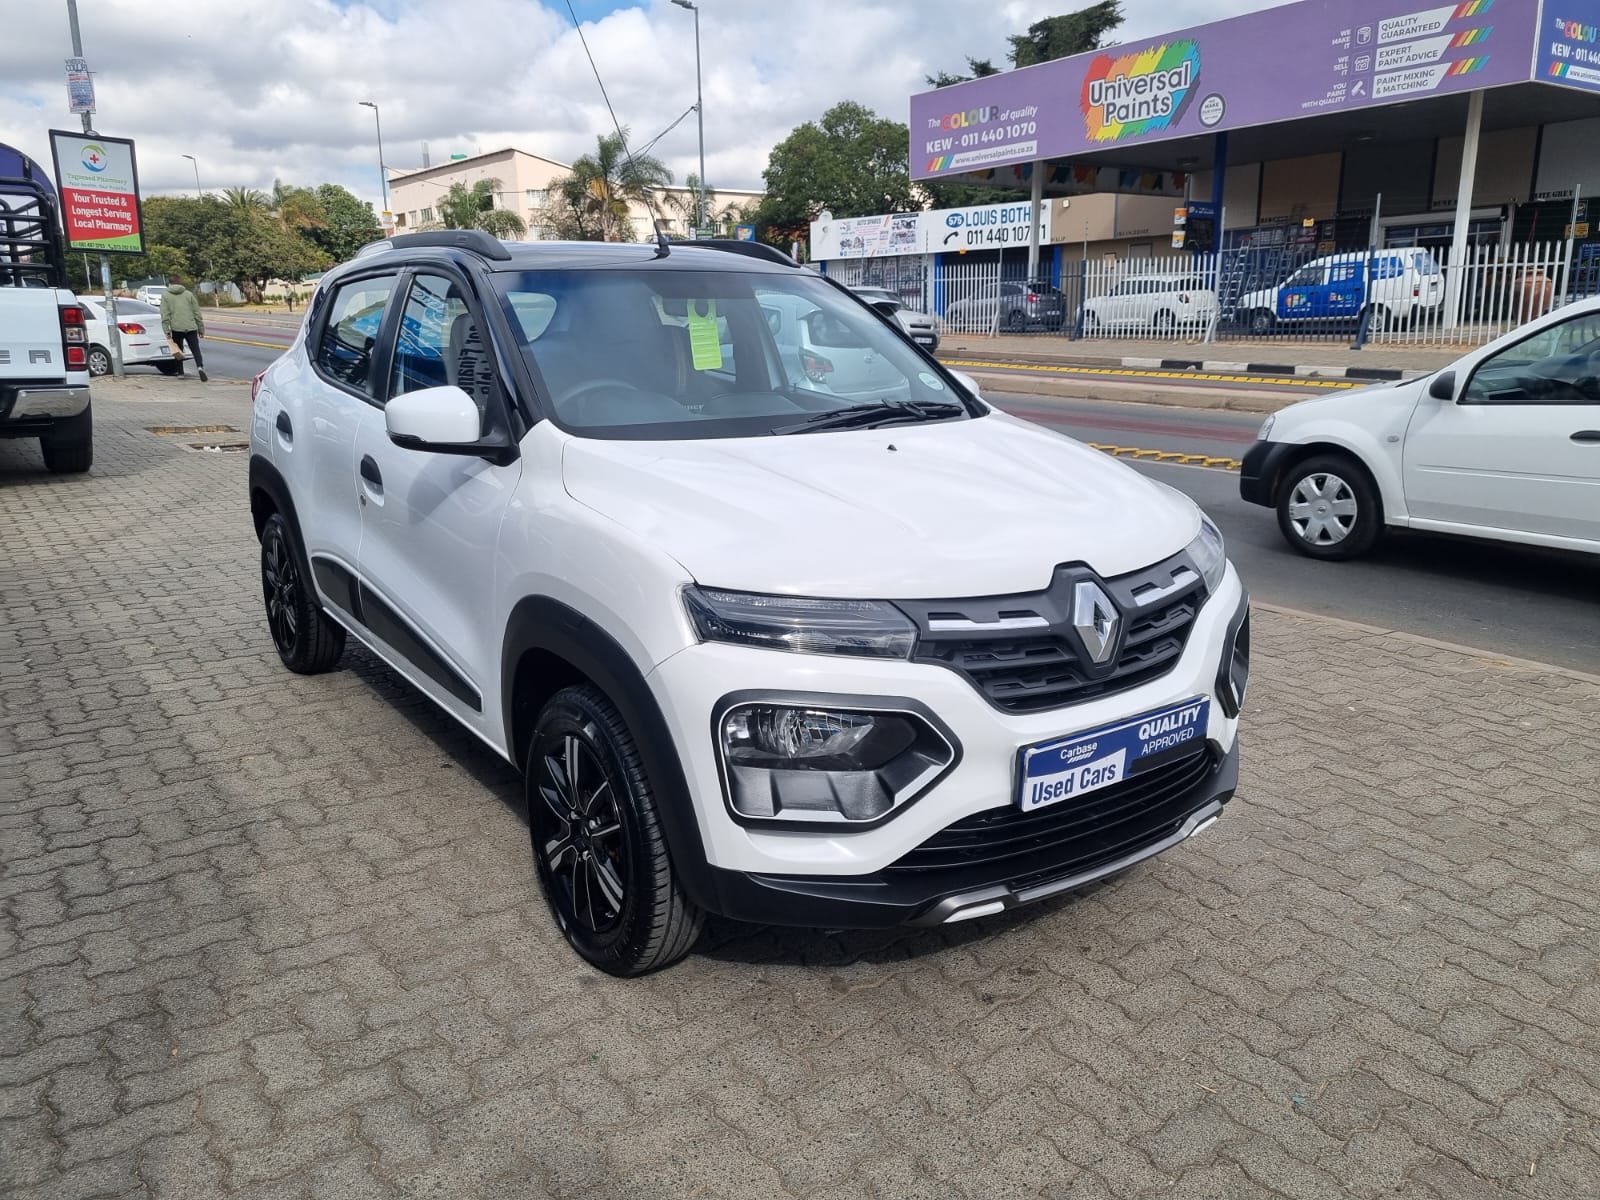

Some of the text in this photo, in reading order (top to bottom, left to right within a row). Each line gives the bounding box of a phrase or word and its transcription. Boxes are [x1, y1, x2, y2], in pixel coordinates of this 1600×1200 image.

[1340, 29, 1351, 37] WE
[1380, 21, 1441, 40] GUARANTEED
[1381, 17, 1419, 32] QUALITY
[1556, 18, 1600, 44] The COLOU
[1332, 37, 1351, 46] MAKE
[1378, 50, 1439, 68] PAINT ADVICE
[1379, 46, 1413, 59] EXPERT
[1551, 42, 1571, 58] KEW
[1575, 48, 1588, 62] 011
[1333, 63, 1349, 72] SELL
[1091, 63, 1190, 104] Universal
[1333, 82, 1347, 90] YOU
[1376, 69, 1436, 87] PAINT MIXING
[1382, 80, 1429, 94] MATCHING
[1302, 96, 1347, 109] WITH QUALITY
[1327, 90, 1347, 98] PAINT
[1105, 93, 1171, 123] Paints
[928, 105, 1039, 132] The COLOUR of quality
[926, 138, 953, 154] KEW
[961, 132, 979, 147] 011
[981, 127, 1004, 144] 440
[1007, 121, 1037, 139] 1070
[72, 192, 128, 207] Your Trusted &
[71, 205, 132, 221] Longest Serving
[966, 209, 997, 227] LOUIS
[1001, 207, 1031, 224] BOTH
[74, 218, 133, 234] Local Pharmacy
[967, 229, 983, 245] 011
[987, 227, 1009, 244] 440
[1138, 705, 1201, 742] QUALITY
[1060, 741, 1098, 760] Carbase
[1141, 727, 1194, 756] APPROVED
[1031, 763, 1116, 805] Used Cars
